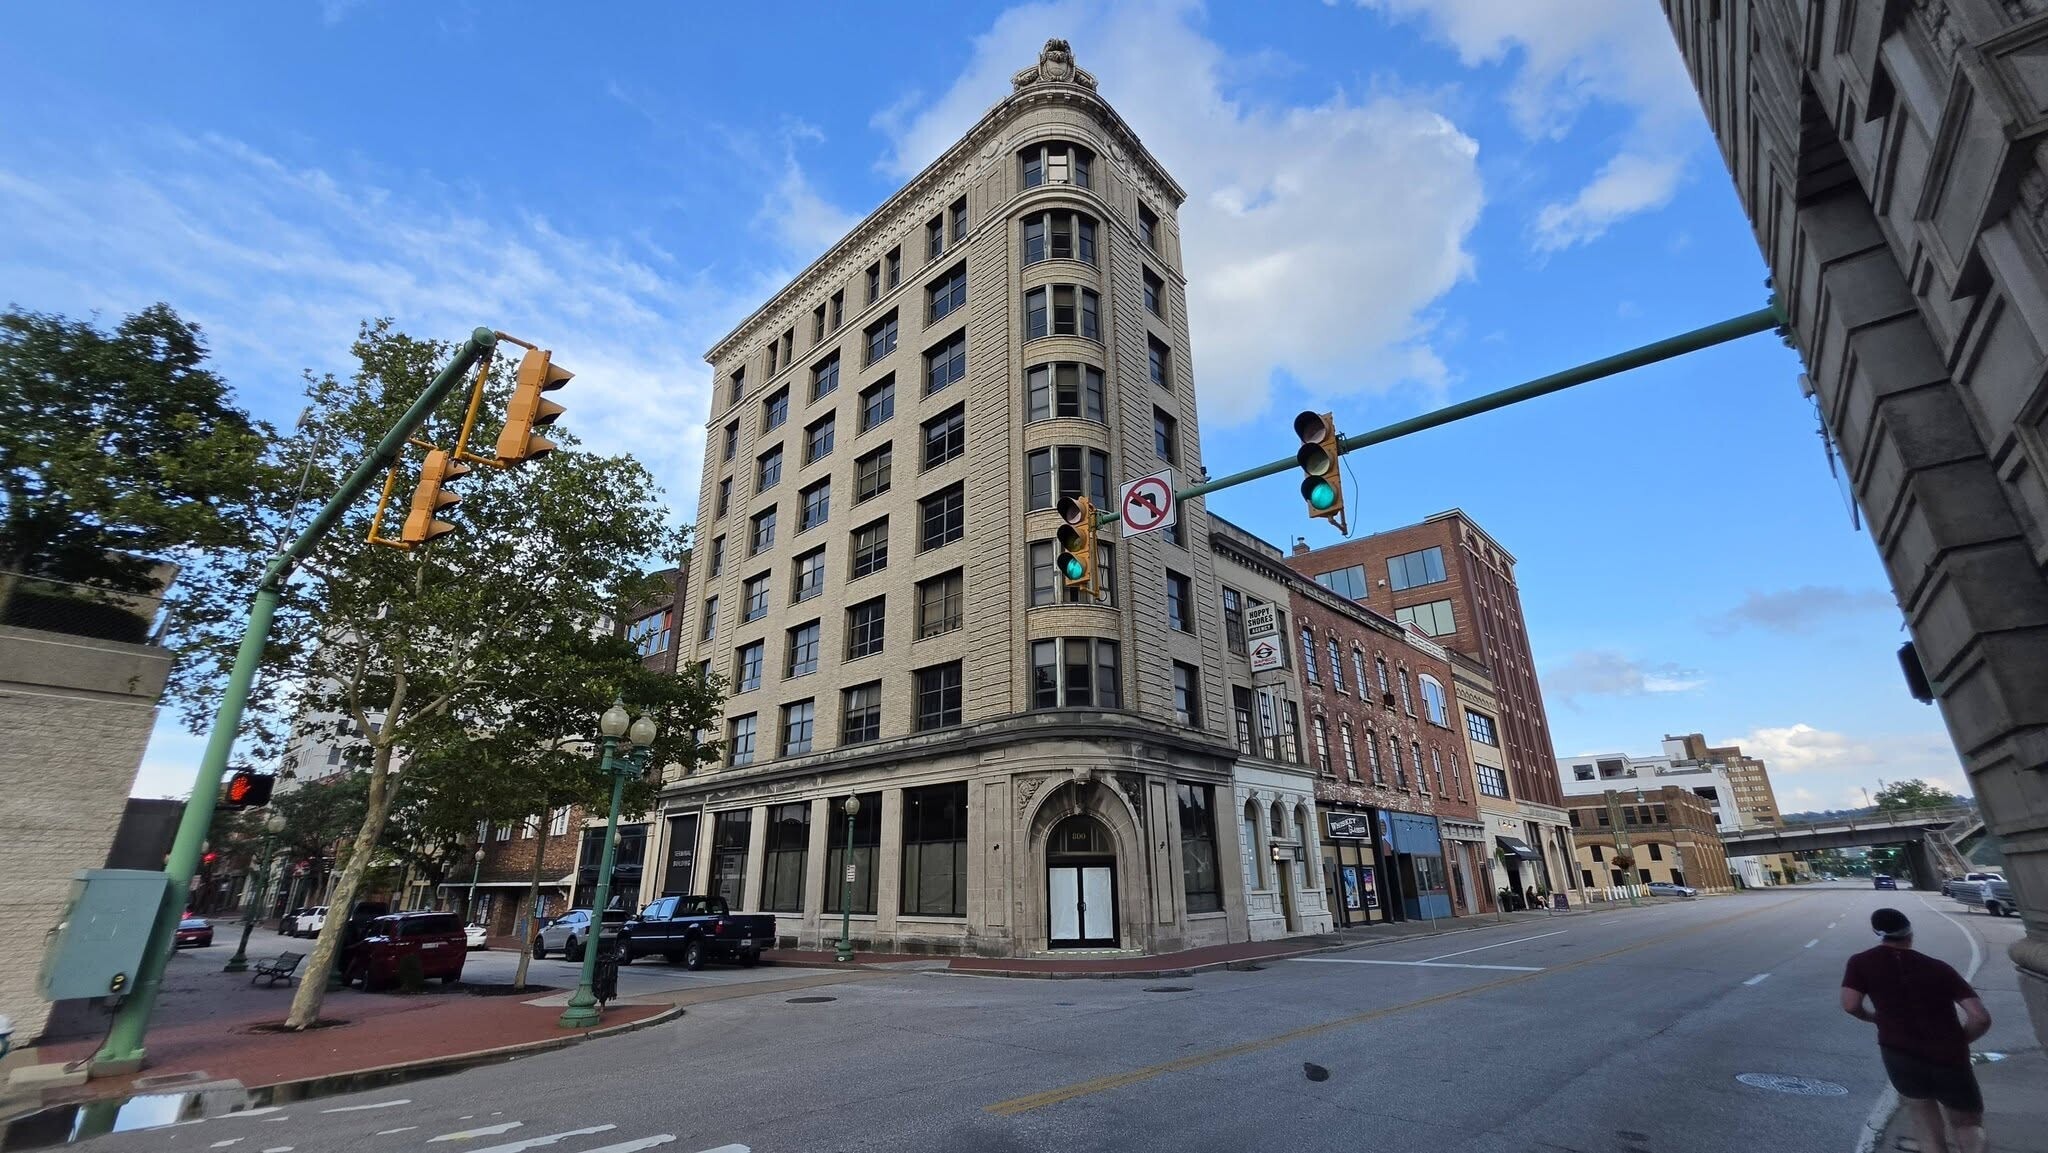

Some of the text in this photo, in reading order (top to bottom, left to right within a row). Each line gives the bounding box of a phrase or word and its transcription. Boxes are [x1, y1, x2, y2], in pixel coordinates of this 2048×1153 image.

[1249, 608, 1270, 619] HOPPY
[1248, 614, 1273, 626] SHORES
[1252, 625, 1271, 633] AGENCY
